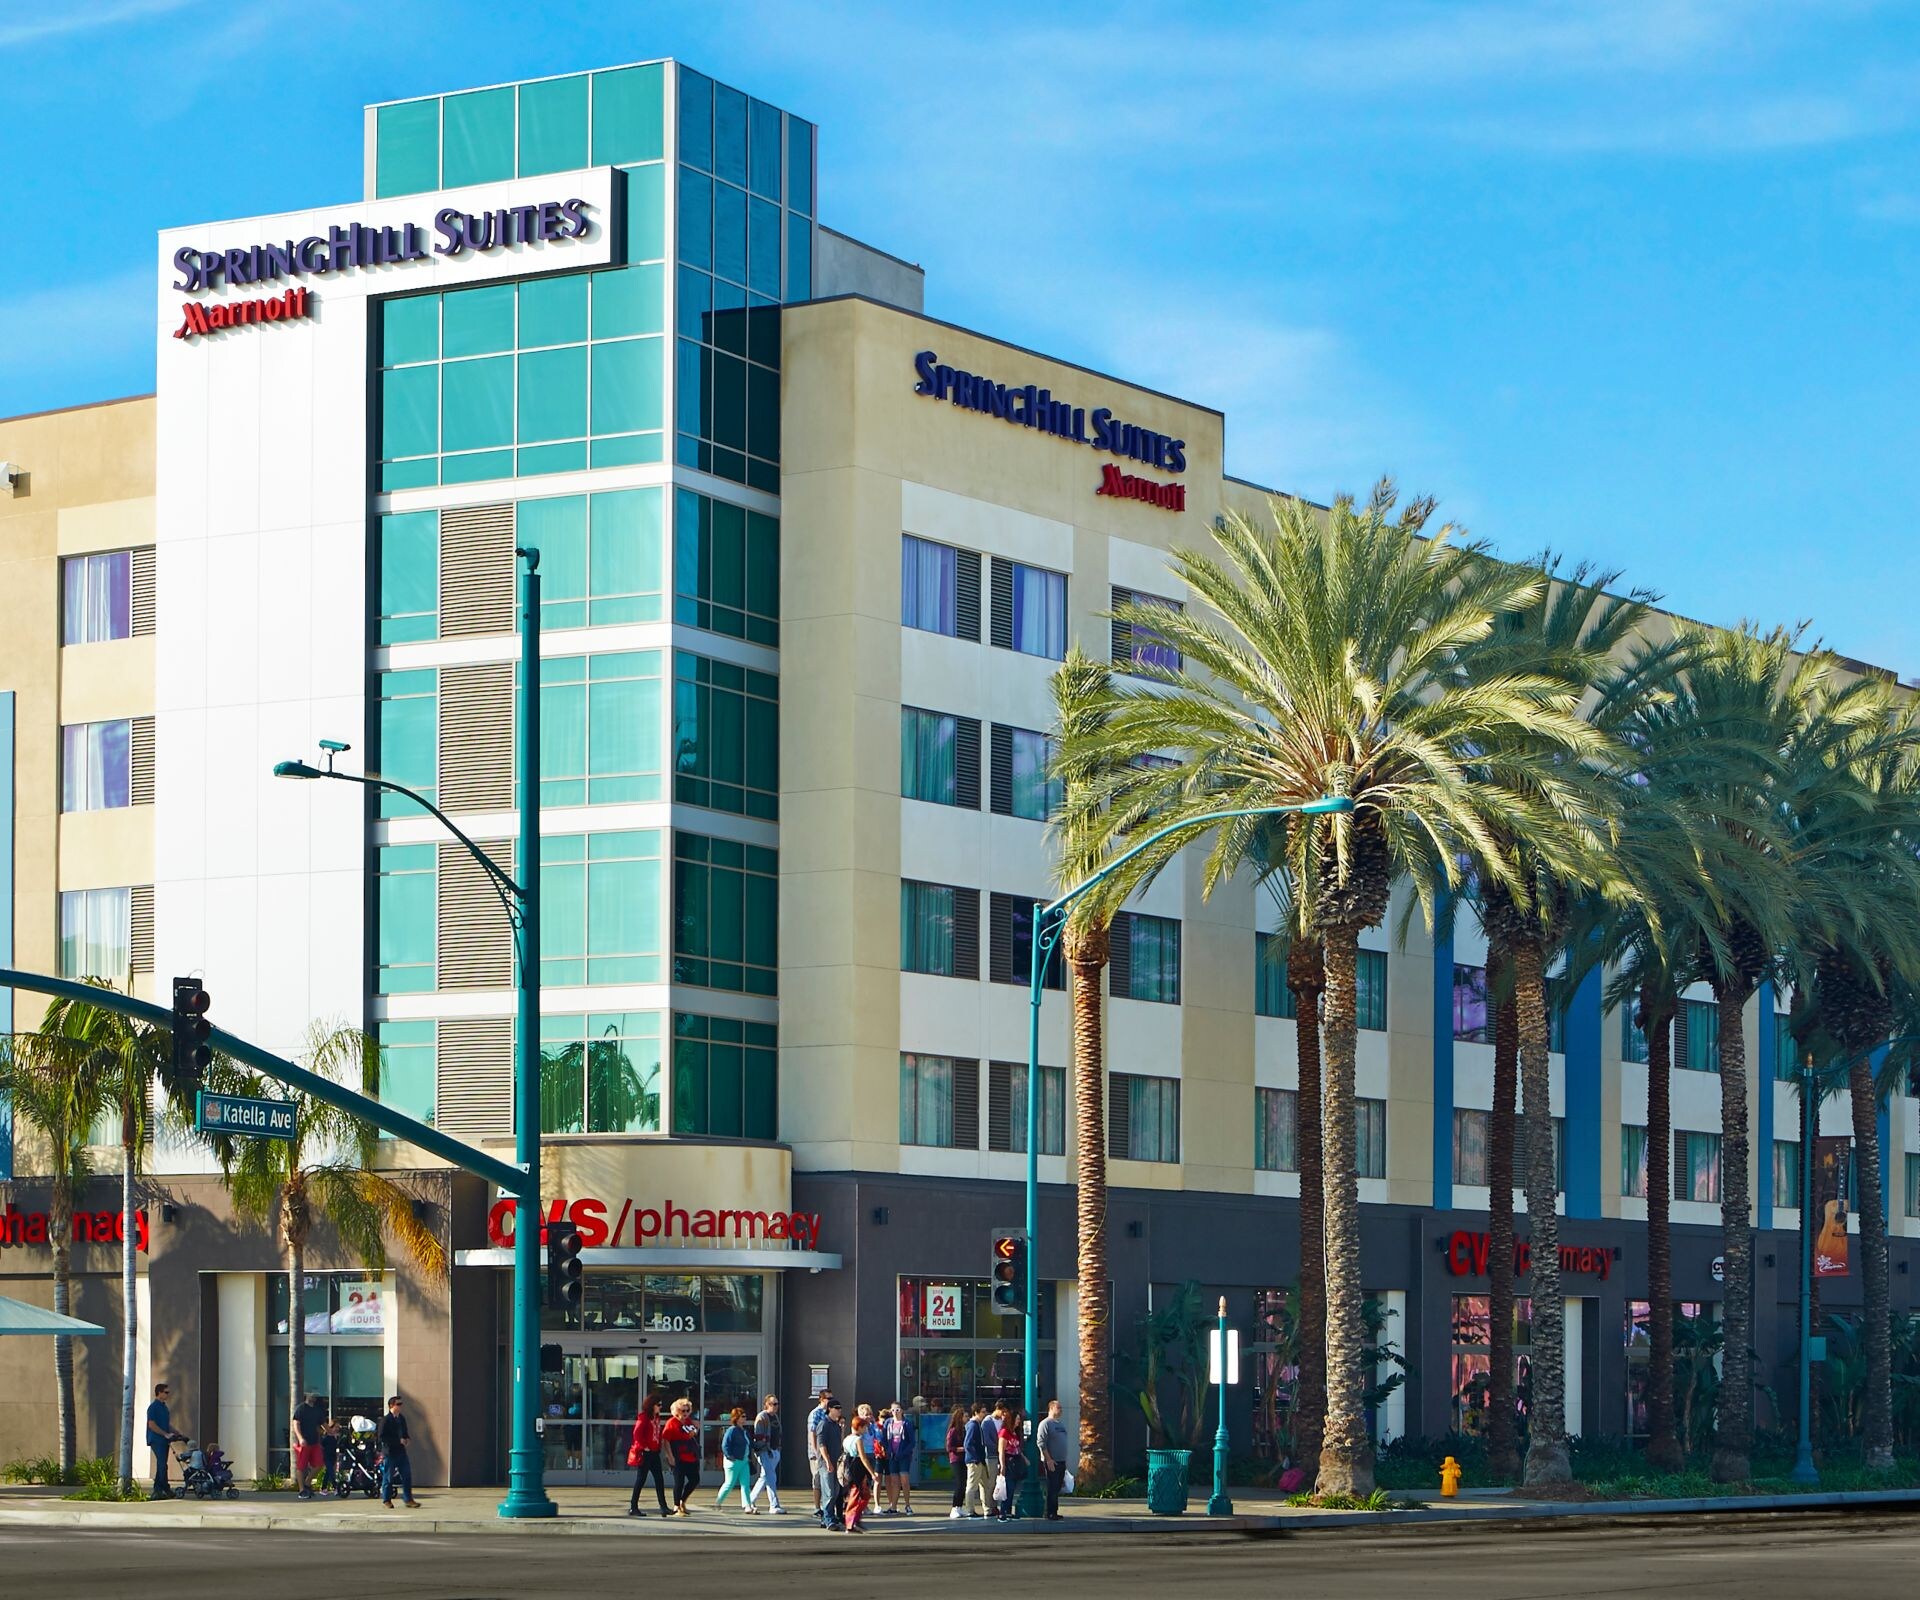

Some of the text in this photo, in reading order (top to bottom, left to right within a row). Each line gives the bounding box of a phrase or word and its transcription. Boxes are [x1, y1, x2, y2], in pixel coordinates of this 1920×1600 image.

[434, 198, 590, 256] SUITES
[173, 286, 309, 340] Marriott
[1091, 407, 1186, 473] SUITES
[1097, 463, 1186, 511] Marriott
[223, 1104, 292, 1129] Katella Ave
[348, 1291, 380, 1314] 24
[932, 1295, 956, 1317] 24
[350, 1315, 382, 1324] HOURS
[932, 1318, 956, 1326] HOURS
